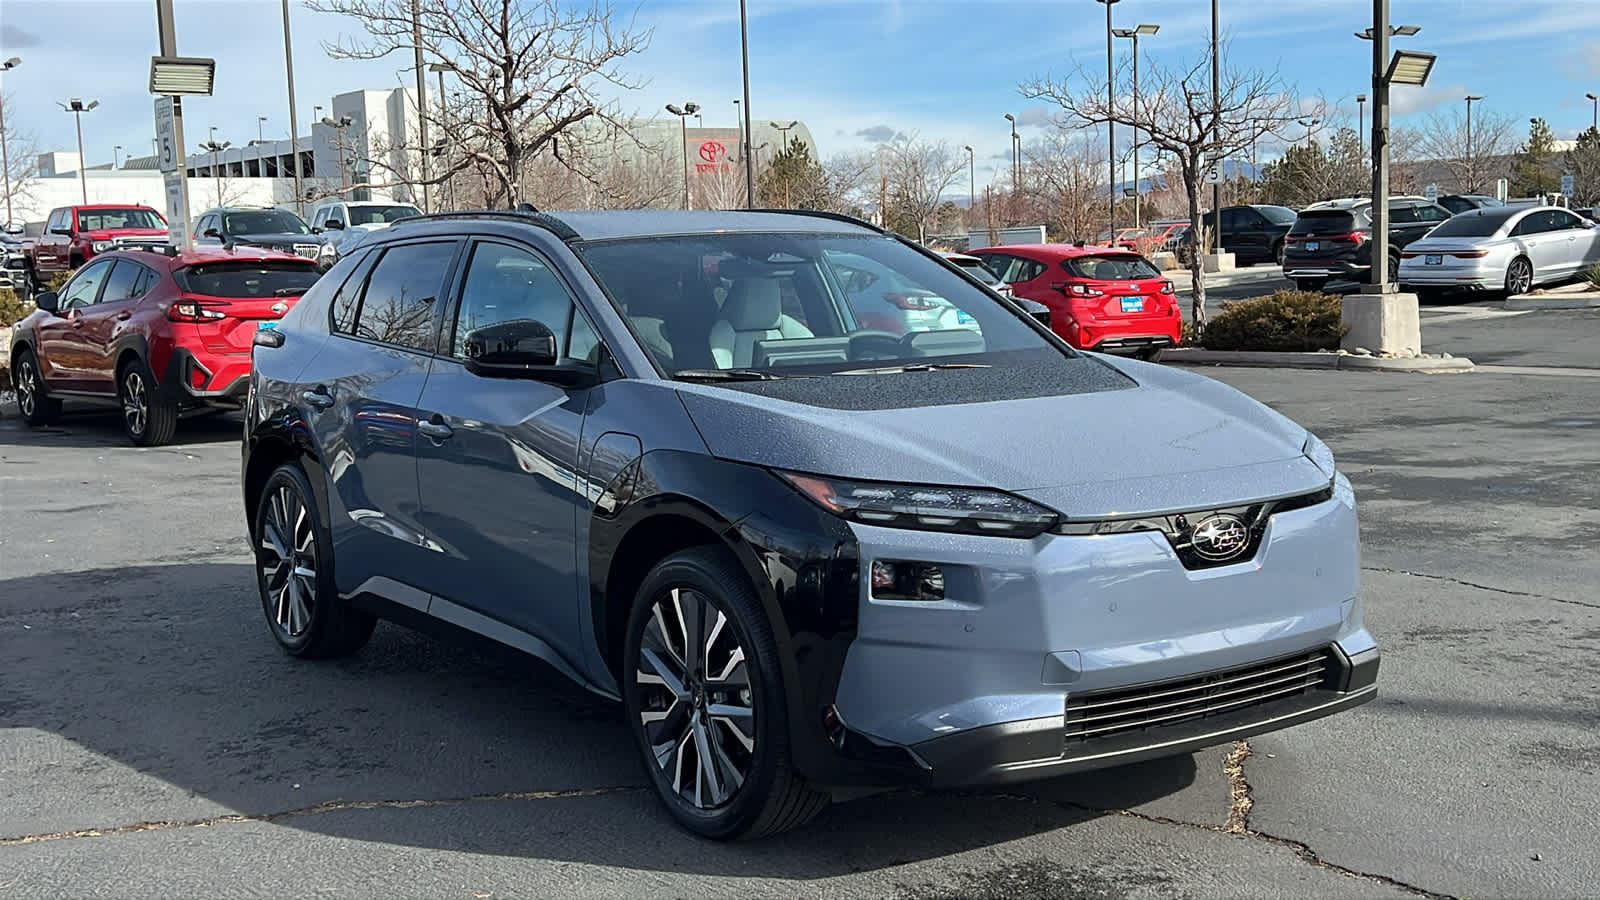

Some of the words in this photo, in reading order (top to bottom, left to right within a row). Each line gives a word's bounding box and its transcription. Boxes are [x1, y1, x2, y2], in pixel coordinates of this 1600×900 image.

[163, 137, 171, 163] 5
[695, 163, 729, 173] TOYOA
[1210, 167, 1218, 180] 5
